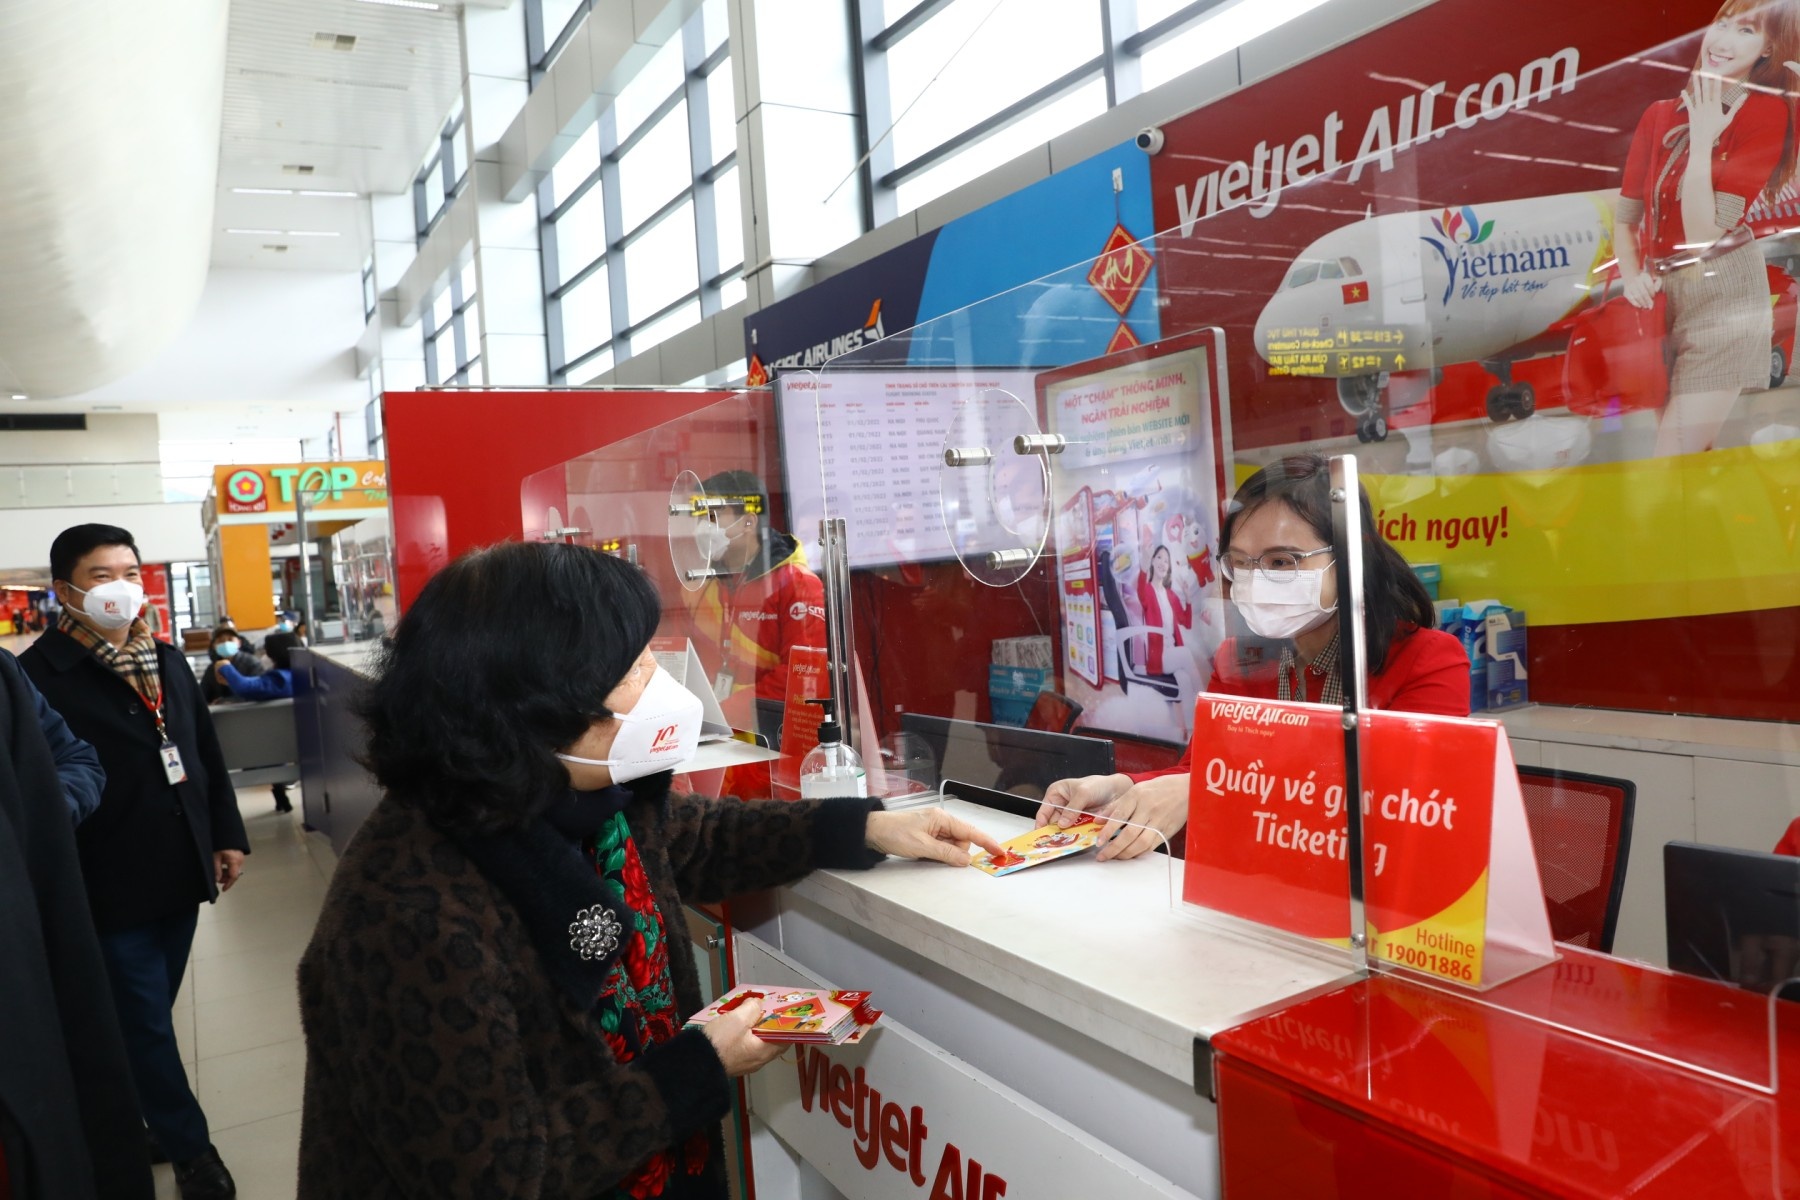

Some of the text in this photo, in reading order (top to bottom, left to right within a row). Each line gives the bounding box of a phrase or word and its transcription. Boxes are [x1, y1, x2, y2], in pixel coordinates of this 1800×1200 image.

[1420, 236, 1571, 307] Vietnam
[804, 328, 863, 366] AIRLINES
[1064, 394, 1082, 410] MỘT
[1121, 379, 1154, 396] THÔNG
[1155, 372, 1187, 390] MINH,
[1081, 410, 1108, 425] NGÀN
[1131, 396, 1170, 413] NGHIỆM
[1142, 416, 1173, 433] WEBSITE
[1174, 413, 1190, 427] MỚI
[270, 466, 358, 506] TOP
[1377, 506, 1508, 549] ích ngay!
[1227, 724, 1237, 733] Bay
[1205, 758, 1276, 804] Quầy
[1284, 770, 1317, 805] vé
[1380, 788, 1457, 830] chót
[1252, 811, 1388, 877] Ticketig
[1385, 942, 1473, 981] 19001886
[1416, 928, 1476, 959] Hotline
